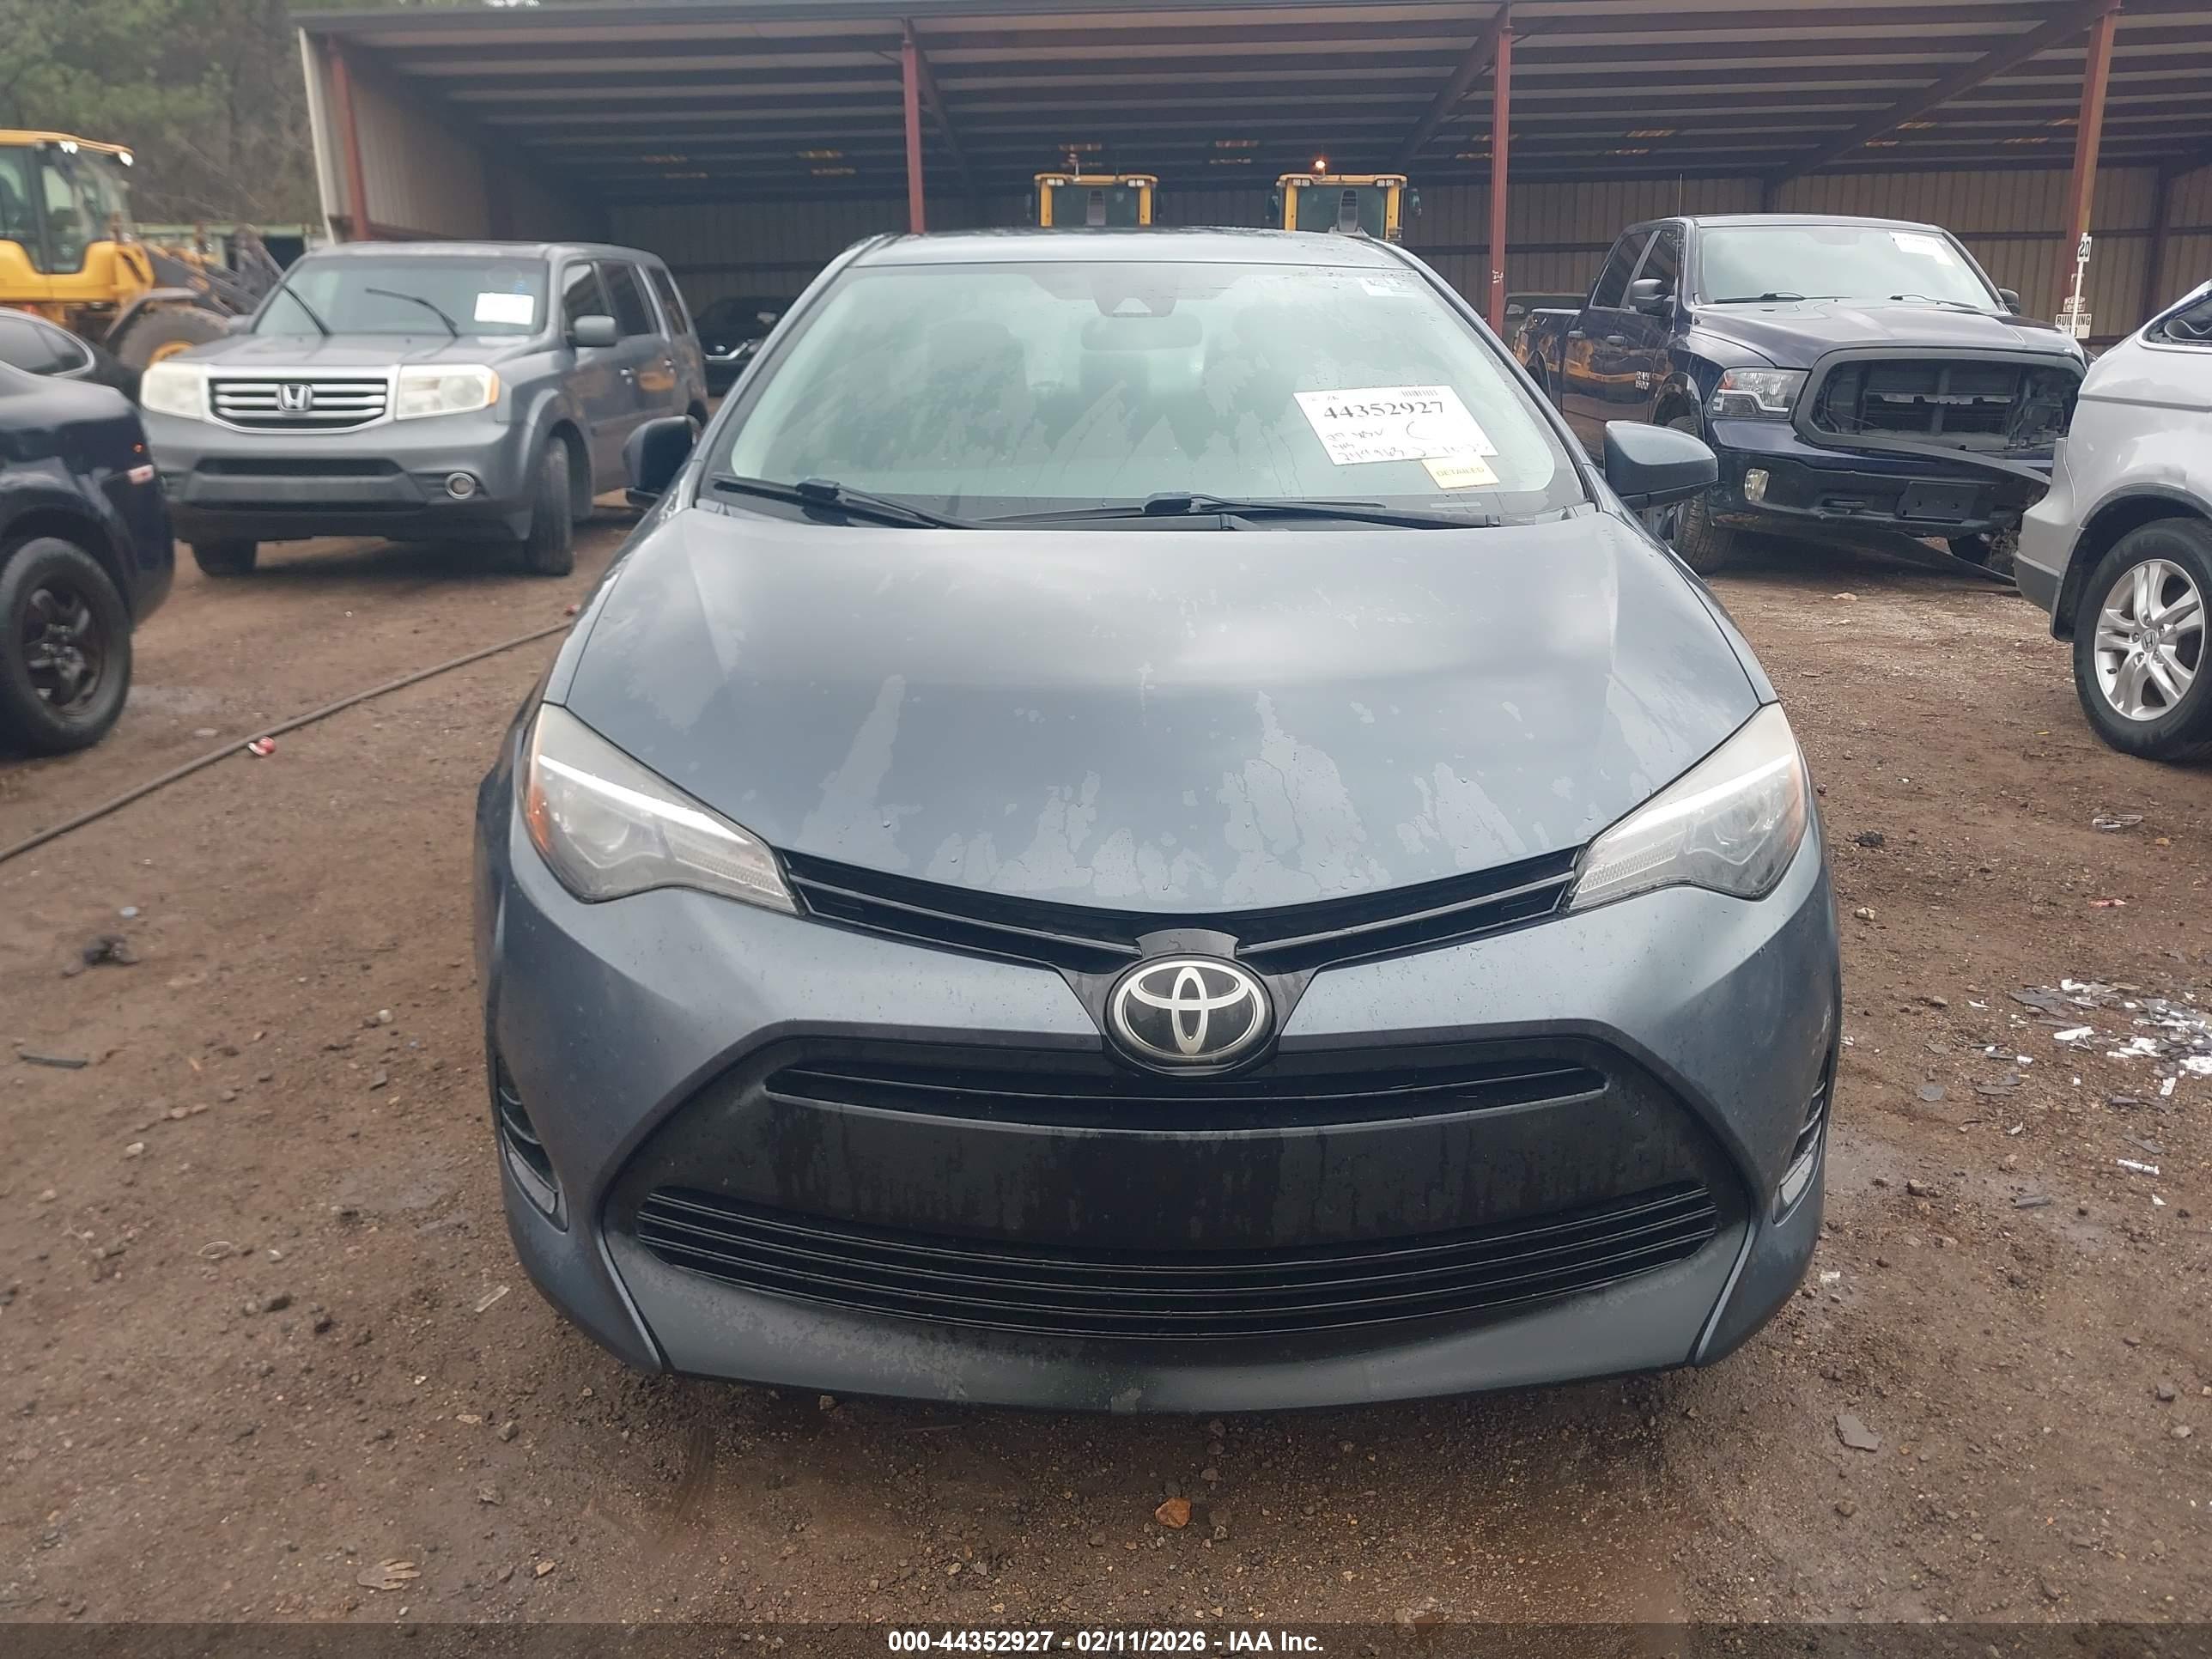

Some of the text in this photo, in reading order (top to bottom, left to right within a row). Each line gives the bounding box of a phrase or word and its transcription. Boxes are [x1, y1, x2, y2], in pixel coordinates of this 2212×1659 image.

[2079, 240, 2090, 258] 20
[1323, 401, 1443, 419] 44352927
[1435, 466, 1485, 477] DETAILED
